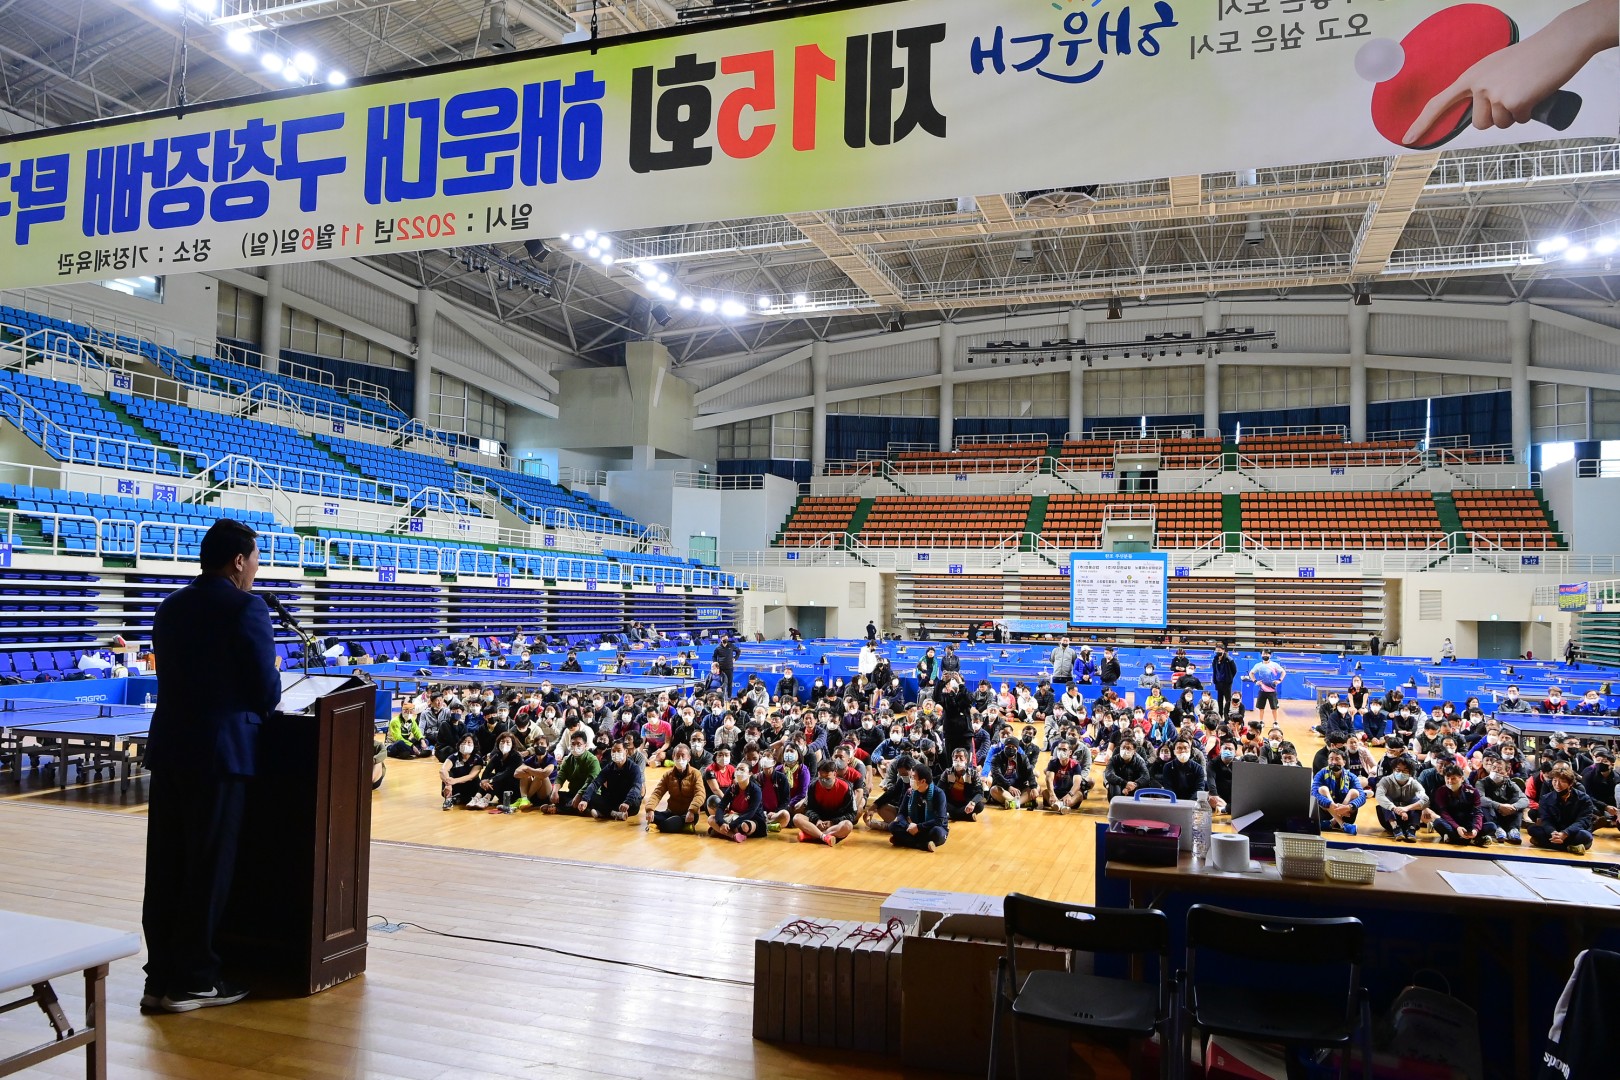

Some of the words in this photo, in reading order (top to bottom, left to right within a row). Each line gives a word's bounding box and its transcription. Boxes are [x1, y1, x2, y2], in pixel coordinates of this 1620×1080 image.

[116, 380, 129, 389] 4-3
[156, 491, 173, 502] 2-3
[412, 523, 422, 531] 2-4
[381, 572, 393, 582] 1-3
[499, 578, 509, 587] 1-4
[75, 694, 107, 703] TAGRO
